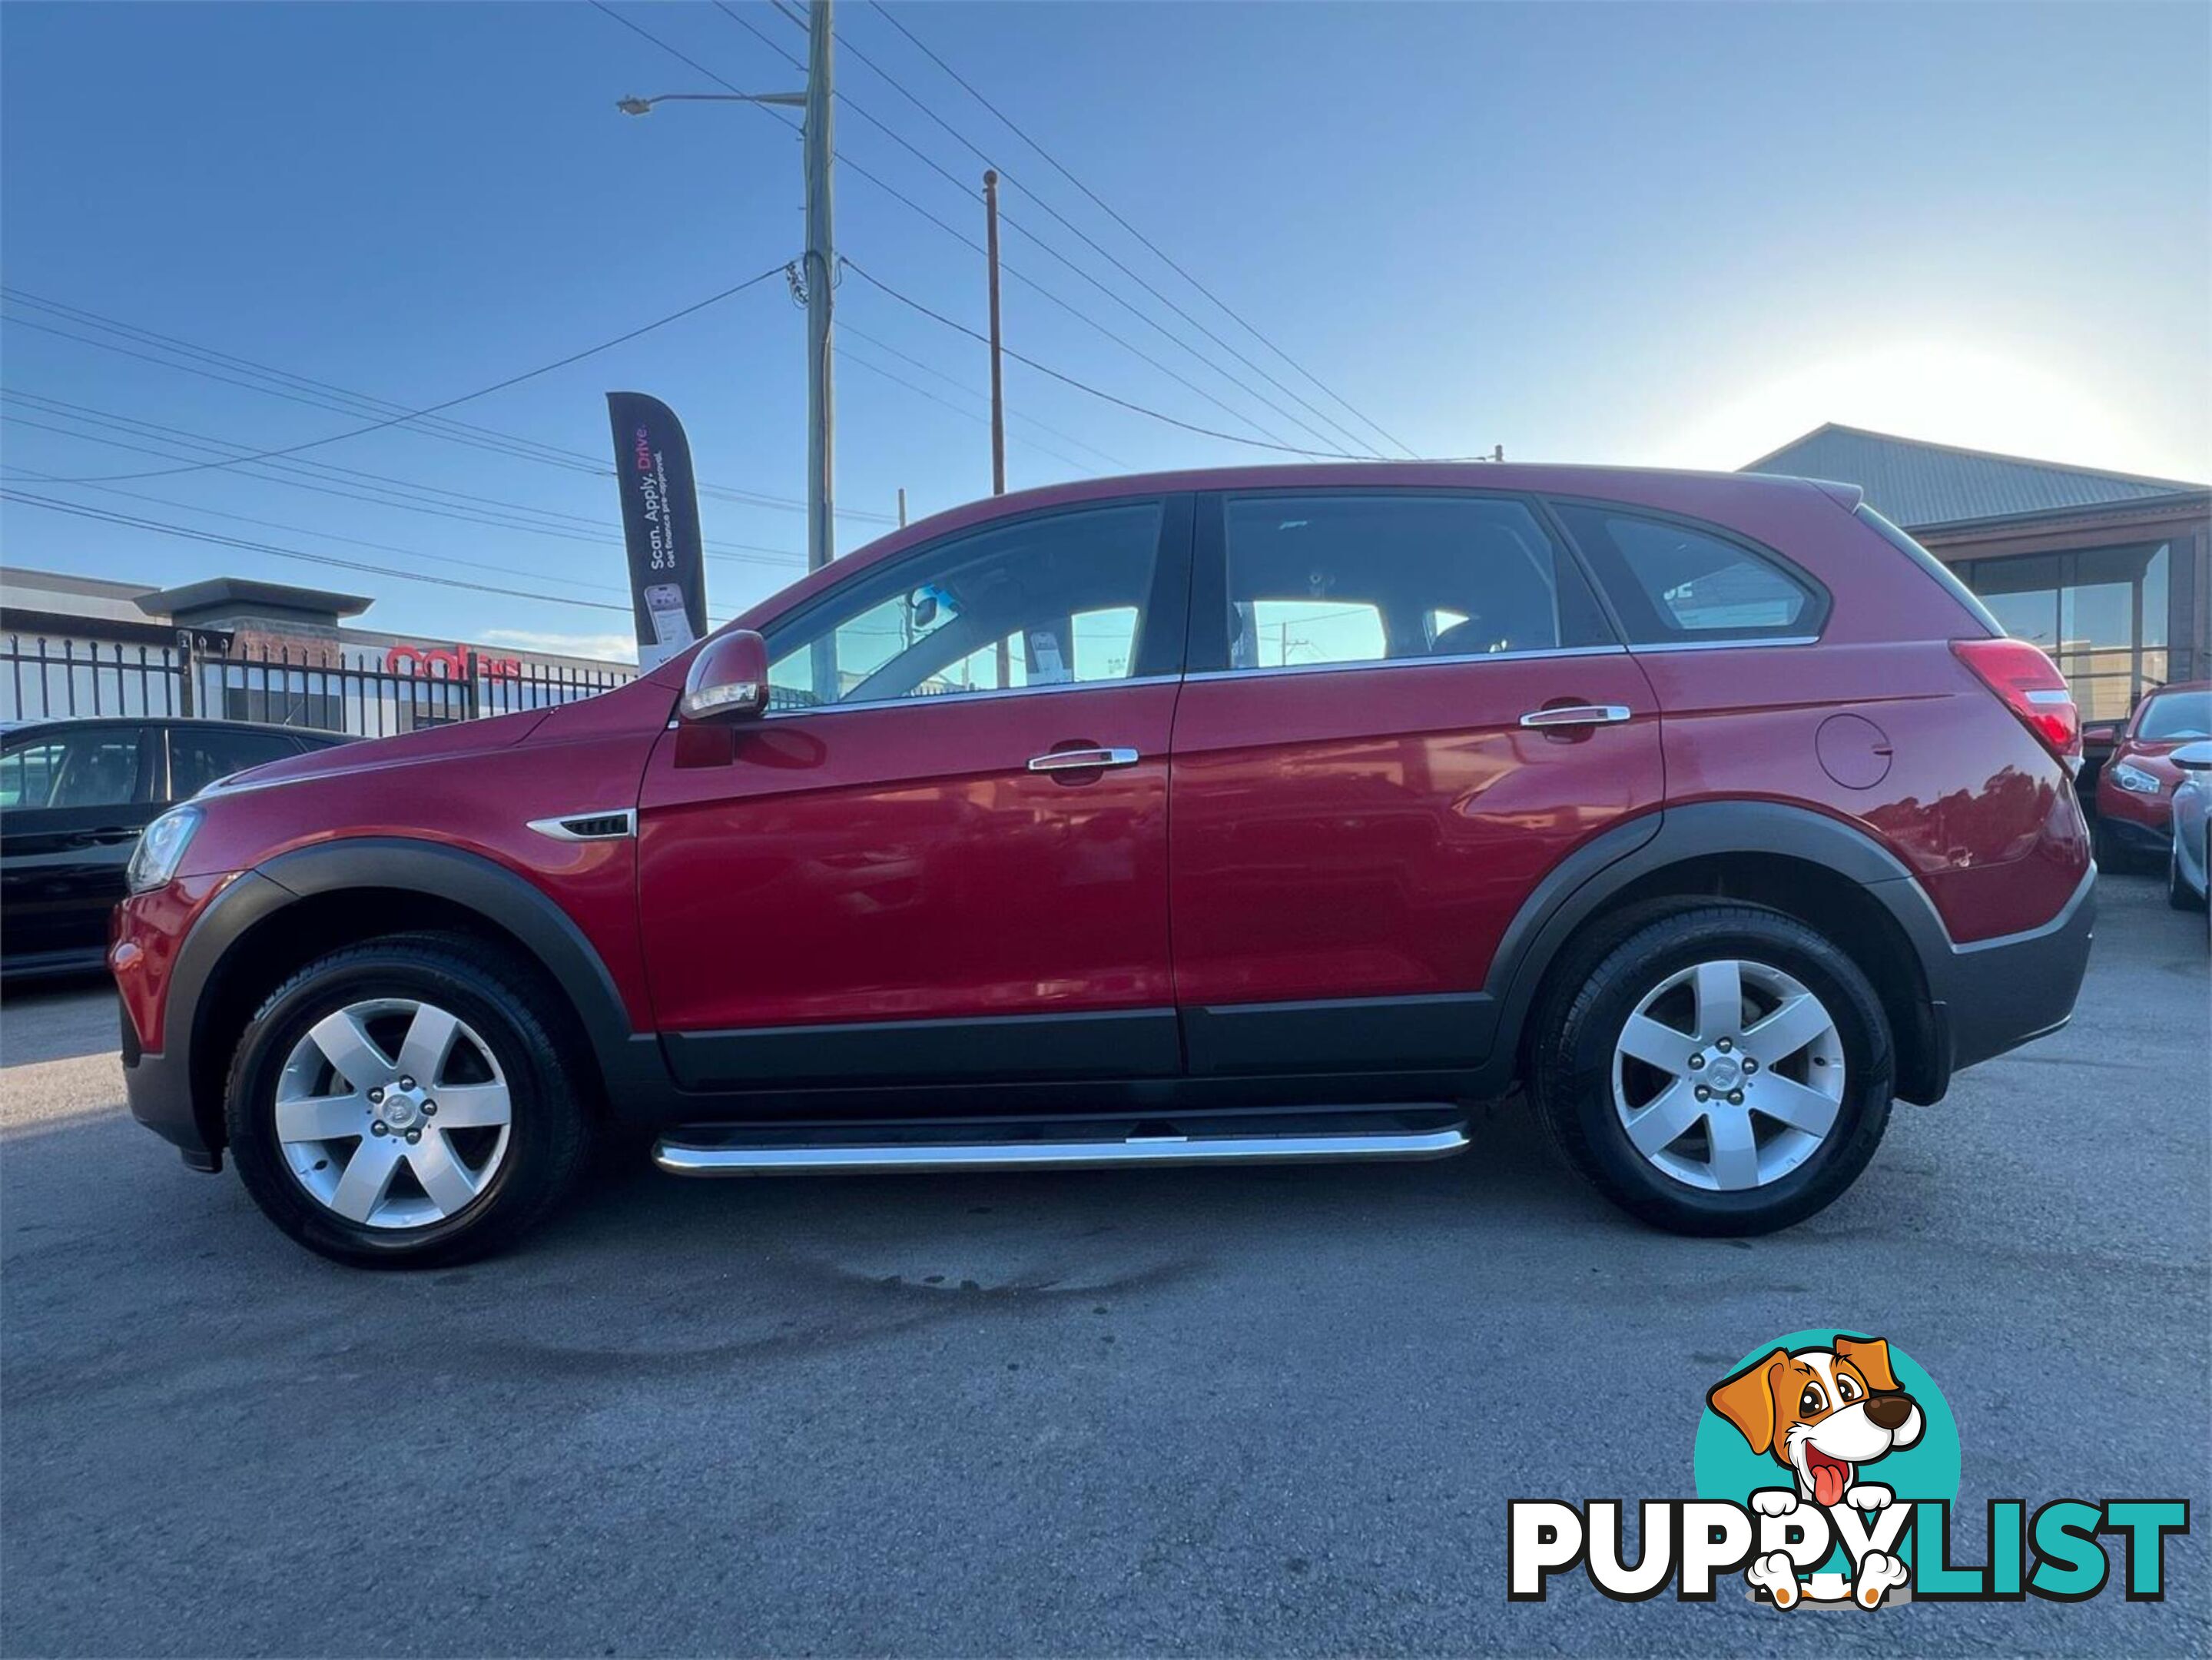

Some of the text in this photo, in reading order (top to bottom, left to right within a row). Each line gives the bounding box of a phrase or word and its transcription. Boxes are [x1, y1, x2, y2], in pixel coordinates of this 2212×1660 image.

[636, 425, 664, 569] Scan. Apply. Drive.
